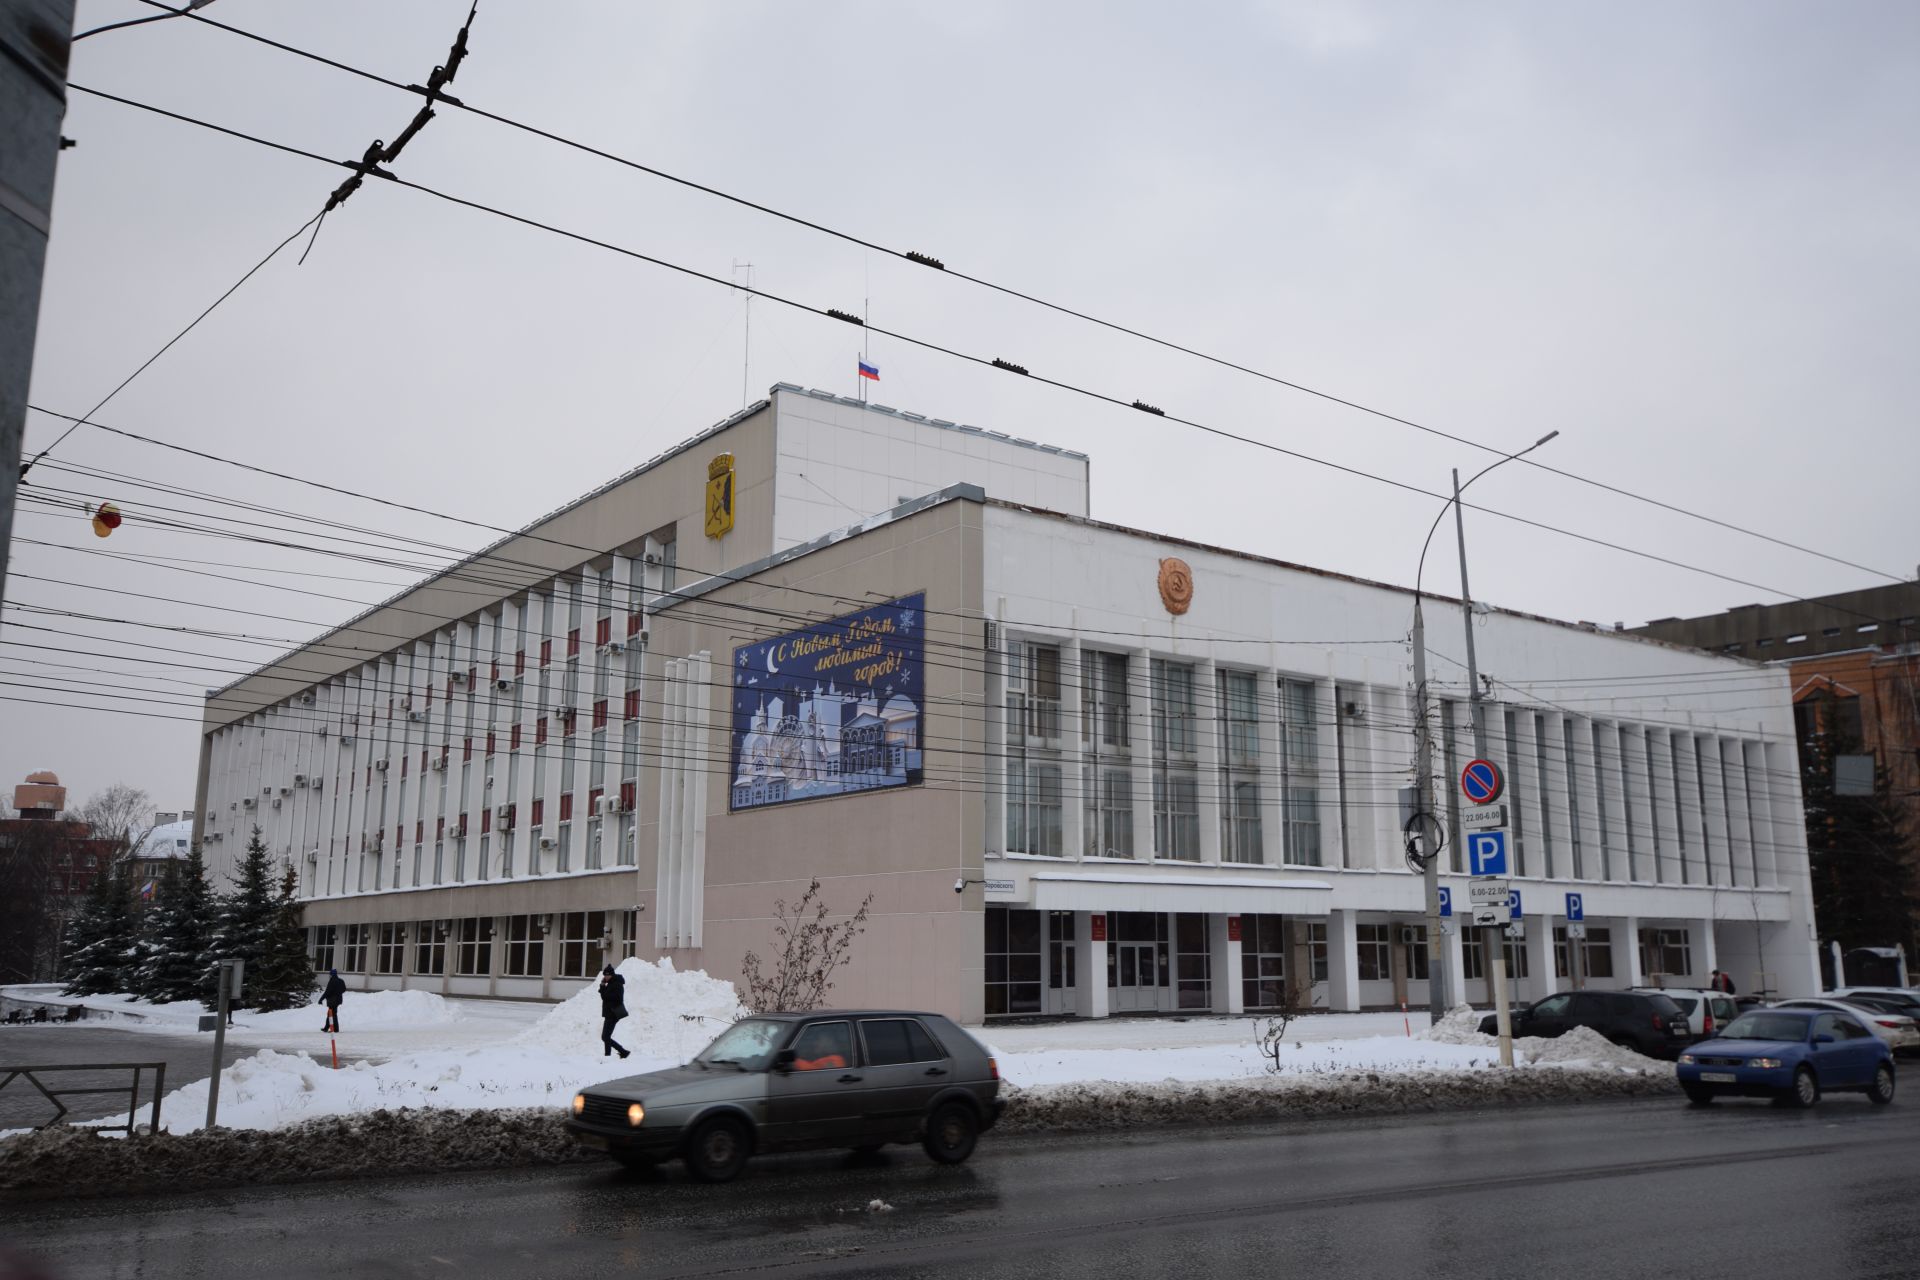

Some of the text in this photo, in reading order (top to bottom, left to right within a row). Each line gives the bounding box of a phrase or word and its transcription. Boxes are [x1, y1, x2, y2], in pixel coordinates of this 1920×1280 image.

[778, 642, 787, 662] С
[790, 634, 841, 658] Новым
[815, 637, 882, 671] любимый
[854, 650, 902, 686] город!
[1466, 811, 1499, 822] 22.00-6.00
[1476, 837, 1499, 872] P
[1471, 887, 1507, 896] 6.00-22.00
[1570, 896, 1580, 918] P
